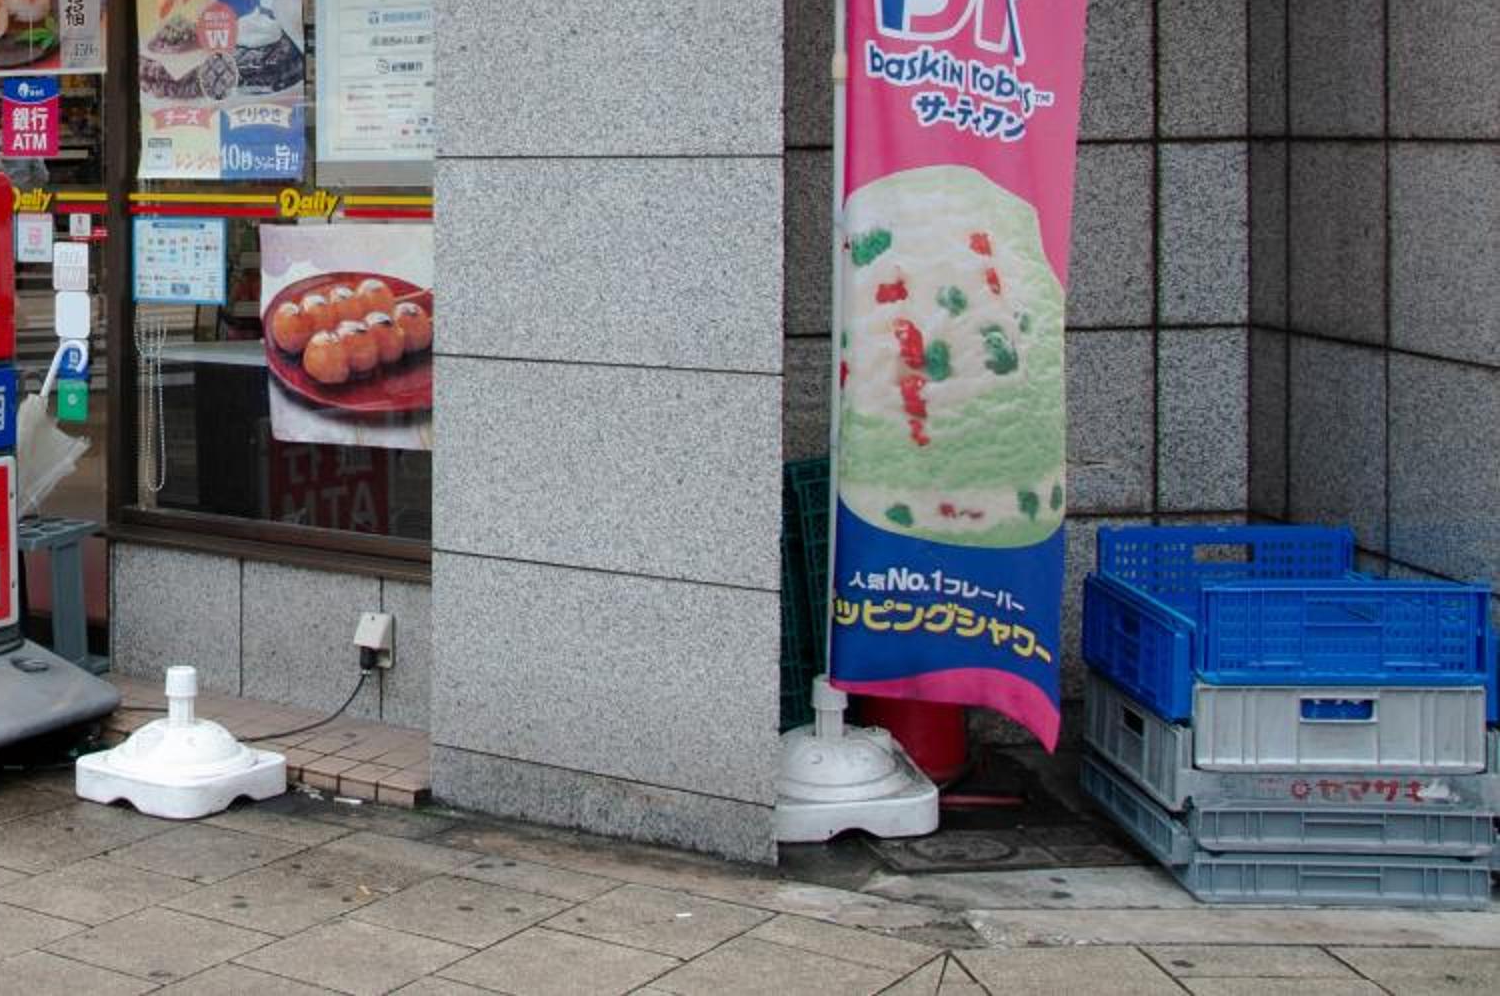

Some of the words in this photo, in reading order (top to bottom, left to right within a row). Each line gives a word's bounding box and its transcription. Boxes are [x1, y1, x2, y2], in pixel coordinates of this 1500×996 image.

[866, 40, 967, 93] baskin
[11, 106, 49, 131] 銀行
[914, 92, 1028, 140] サーティワン
[12, 132, 48, 151] ATM
[278, 188, 341, 219] Daily
